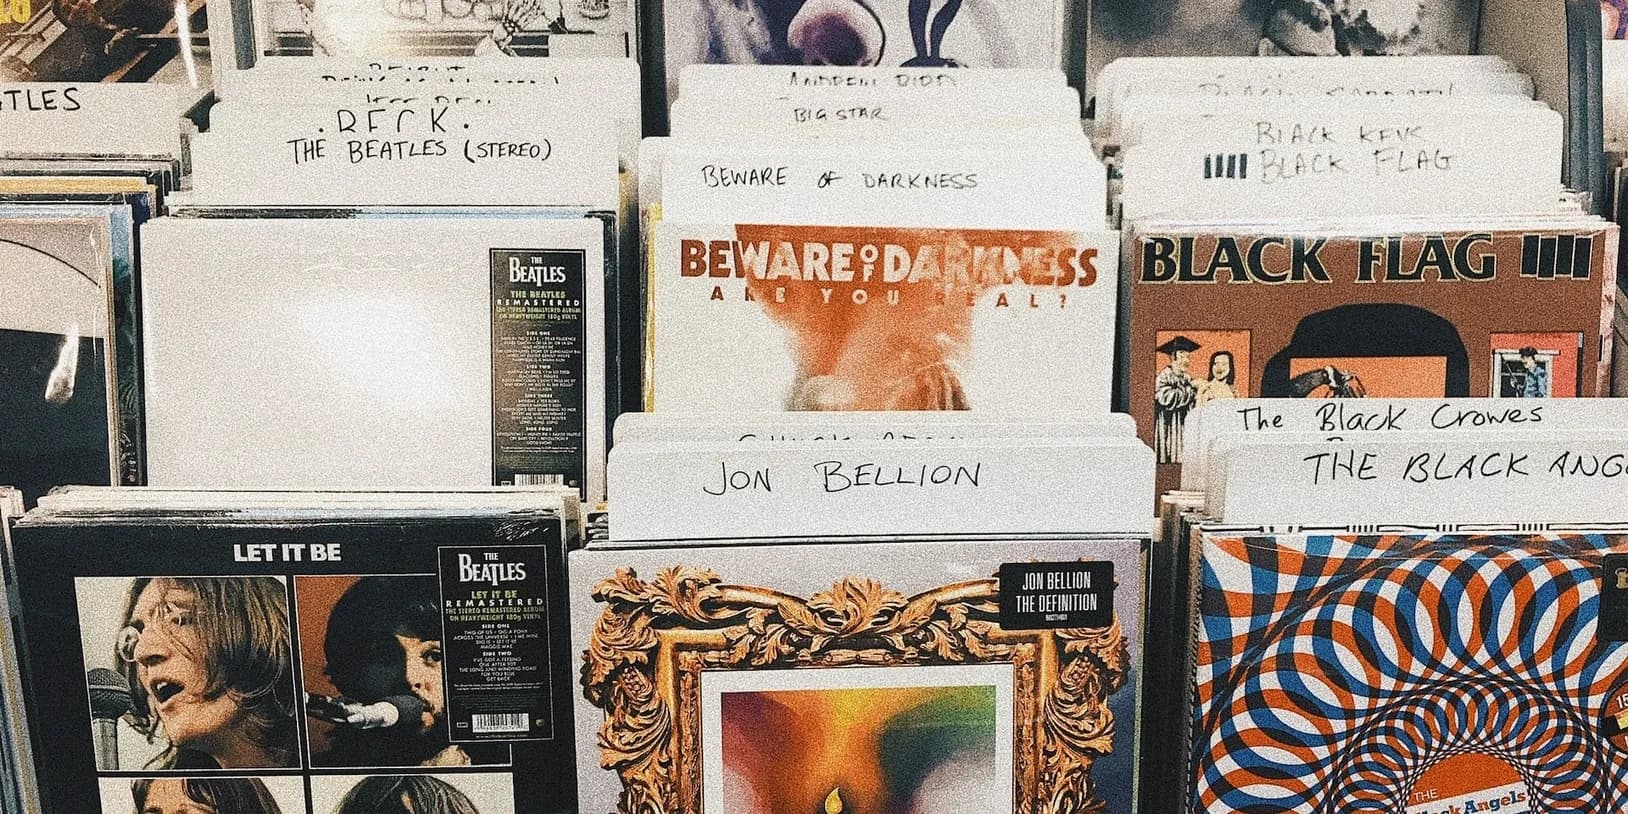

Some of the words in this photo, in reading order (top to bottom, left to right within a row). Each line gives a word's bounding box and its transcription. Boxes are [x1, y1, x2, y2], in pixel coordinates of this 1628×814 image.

[0, 87, 80, 111] TLES
[794, 108, 827, 122] BIG
[836, 107, 886, 121] STAR
[287, 138, 326, 164] THE
[348, 139, 447, 163] BEATLES
[464, 138, 552, 163] (STEREO)
[702, 164, 788, 188] BEWARE
[817, 170, 843, 187] OF
[864, 172, 979, 189] DARKNESS
[1261, 149, 1348, 184] BLACK
[1374, 147, 1454, 176] FLAG
[680, 239, 855, 281] BEWARE
[883, 244, 1098, 287] DARKNESS
[1139, 234, 1330, 284] BLACK
[1354, 233, 1496, 284] FLAG
[509, 257, 567, 287] BEATLES
[711, 286, 786, 303] ARE
[820, 288, 900, 305] YOU
[1237, 408, 1283, 430] The
[1315, 403, 1407, 431] Black
[1431, 403, 1544, 430] Crowes
[703, 461, 772, 496] JON
[813, 460, 981, 493] BELLION
[1303, 450, 1378, 485] THE
[1402, 452, 1529, 484] BLACK
[233, 543, 277, 562] LET
[282, 543, 306, 562] IT
[310, 543, 342, 562] BE
[483, 552, 499, 561] THE
[458, 553, 527, 587] BEATLES
[1022, 572, 1044, 591] JON
[1047, 571, 1091, 590] BELLION
[446, 598, 543, 608] REMASTERED
[471, 590, 488, 600] LET
[491, 590, 501, 599] IT
[504, 590, 517, 599] BE
[1016, 595, 1036, 613] THE
[1038, 593, 1098, 612] DEFINITION
[1414, 788, 1438, 802] THE
[1463, 790, 1526, 814] Angels
